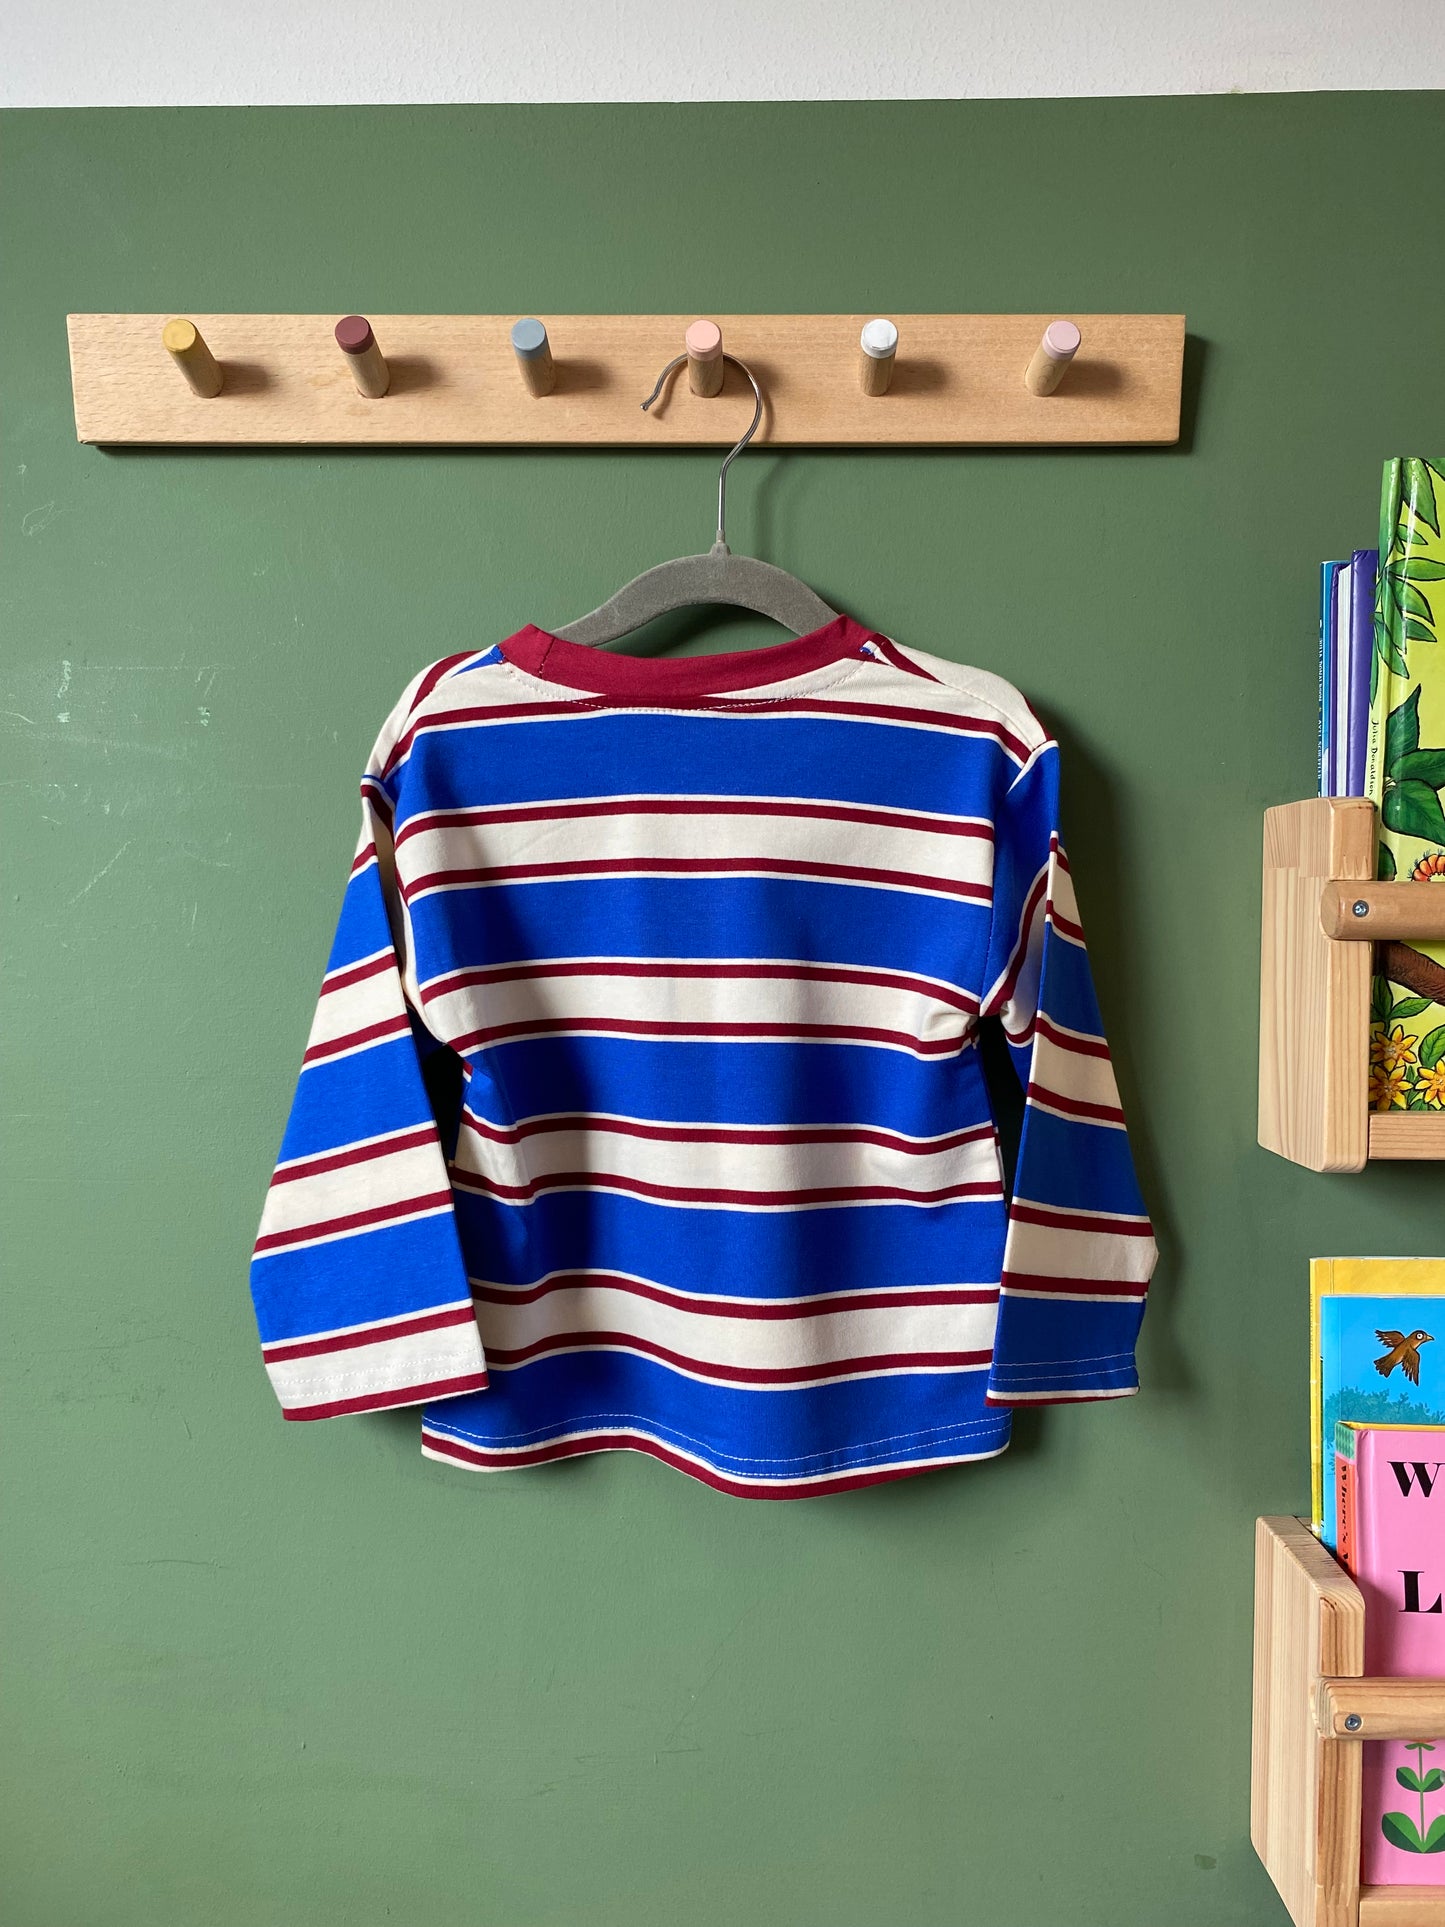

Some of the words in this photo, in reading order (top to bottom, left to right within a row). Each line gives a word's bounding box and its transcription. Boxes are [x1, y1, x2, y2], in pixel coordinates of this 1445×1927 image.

[1371, 719, 1379, 744] Julia
[1368, 746, 1378, 796] Donaldson
[1397, 1570, 1443, 1614] L
